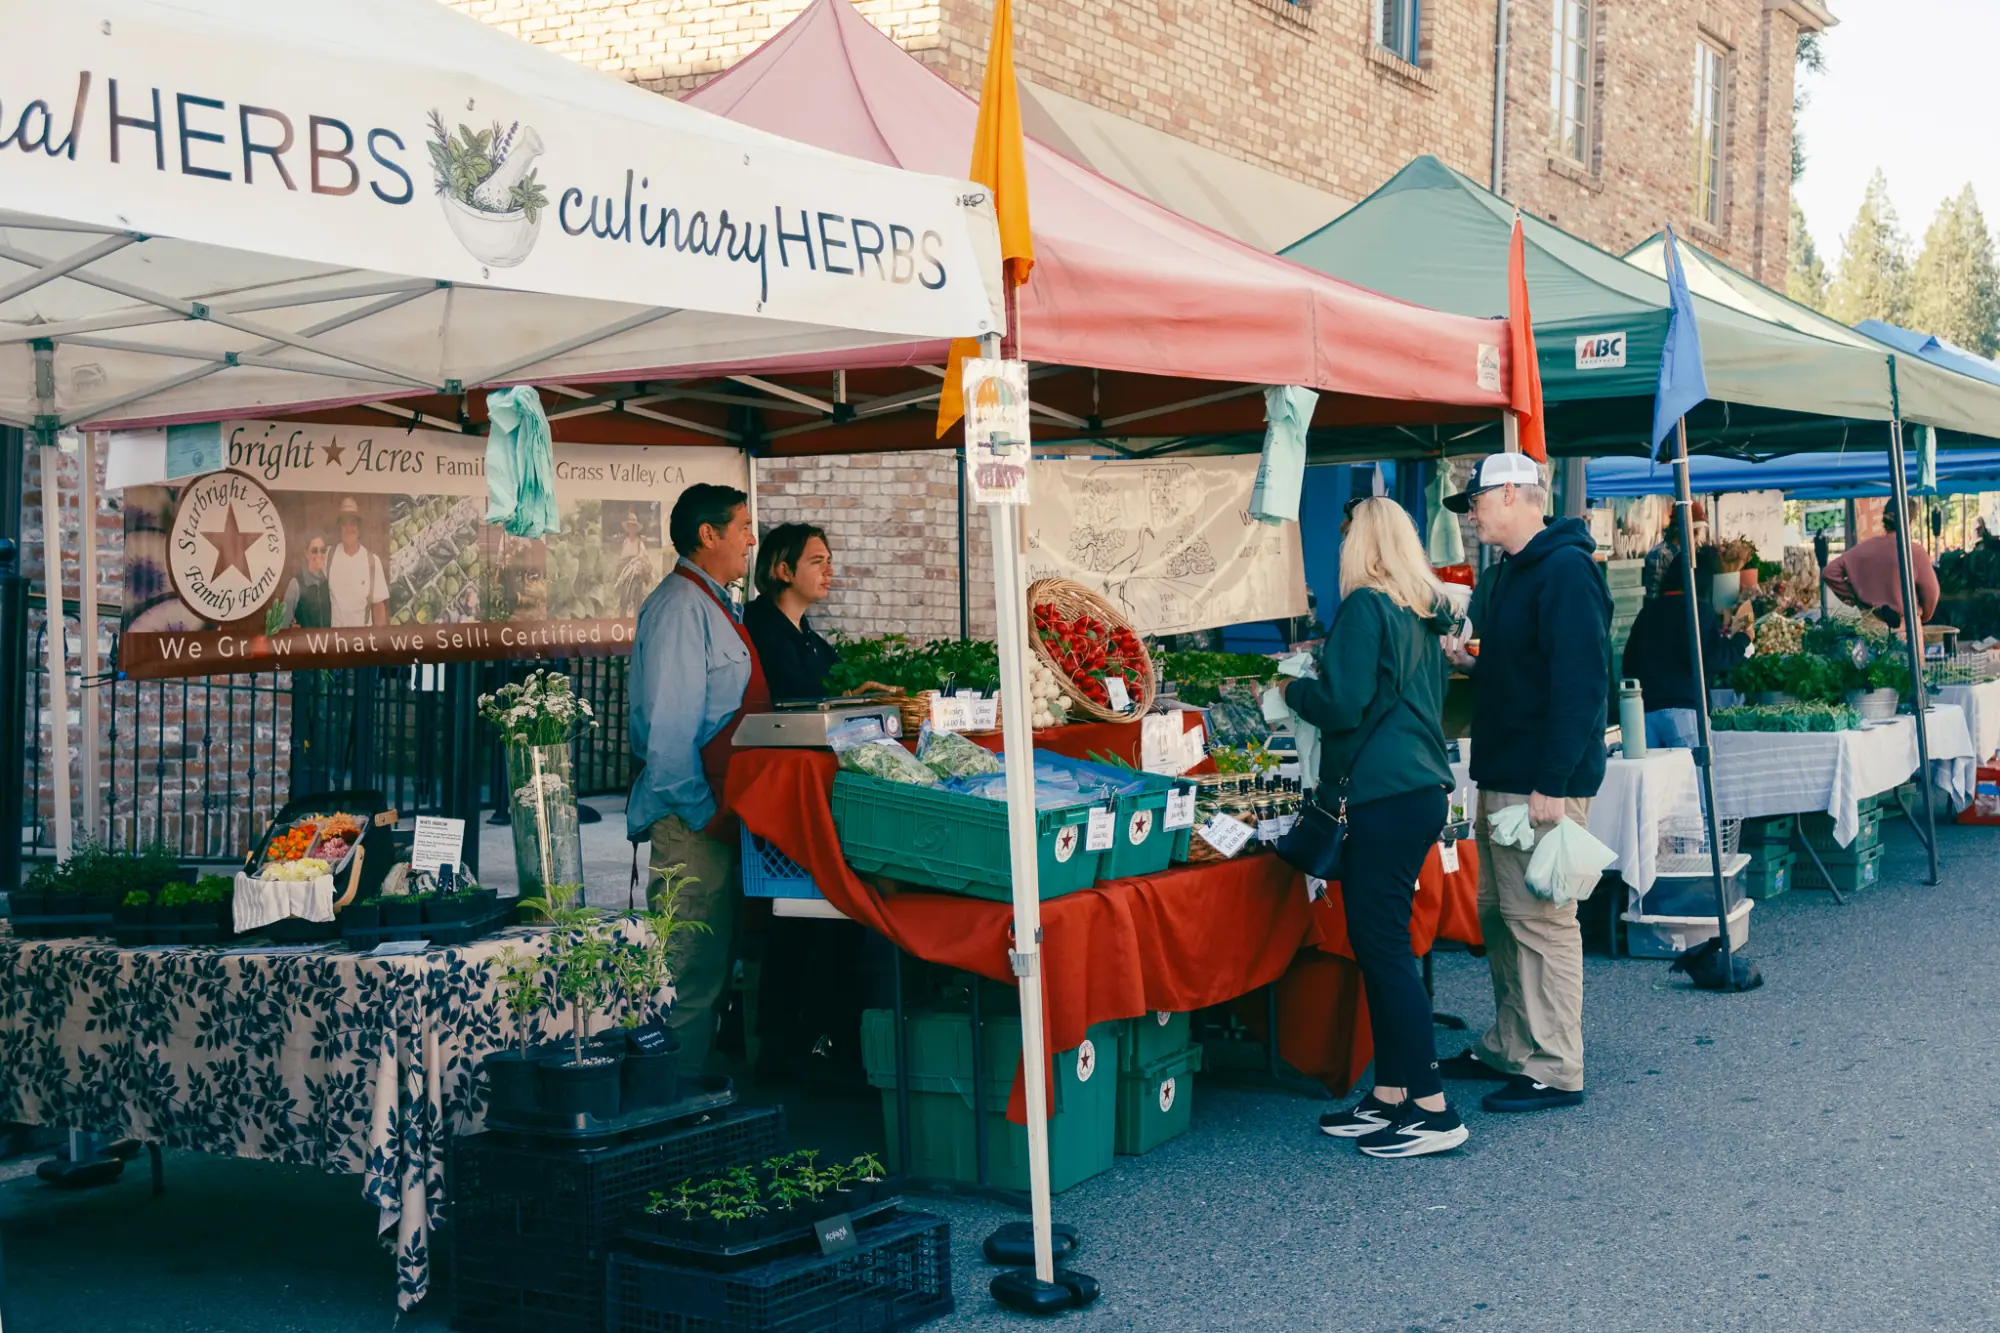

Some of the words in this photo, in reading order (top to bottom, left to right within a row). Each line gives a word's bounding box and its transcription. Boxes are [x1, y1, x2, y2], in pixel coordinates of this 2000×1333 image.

[0, 71, 92, 162] al
[107, 78, 414, 206] HERBS
[558, 169, 768, 304] culinary
[774, 205, 948, 291] HERBS
[1580, 337, 1623, 359] ABC
[228, 427, 315, 481] bright
[345, 438, 426, 476] Acres
[435, 455, 486, 477] Famil
[556, 461, 604, 481] Grass
[663, 465, 686, 483] CA
[178, 476, 249, 555] Starbright
[247, 496, 280, 555] Acres
[184, 565, 236, 618] Family
[238, 566, 276, 609] Farm
[159, 637, 202, 660] We
[217, 635, 293, 658] Grw
[306, 631, 379, 655] What
[390, 634, 425, 651] we
[435, 627, 491, 650] Sell!
[500, 623, 602, 647] Certified
